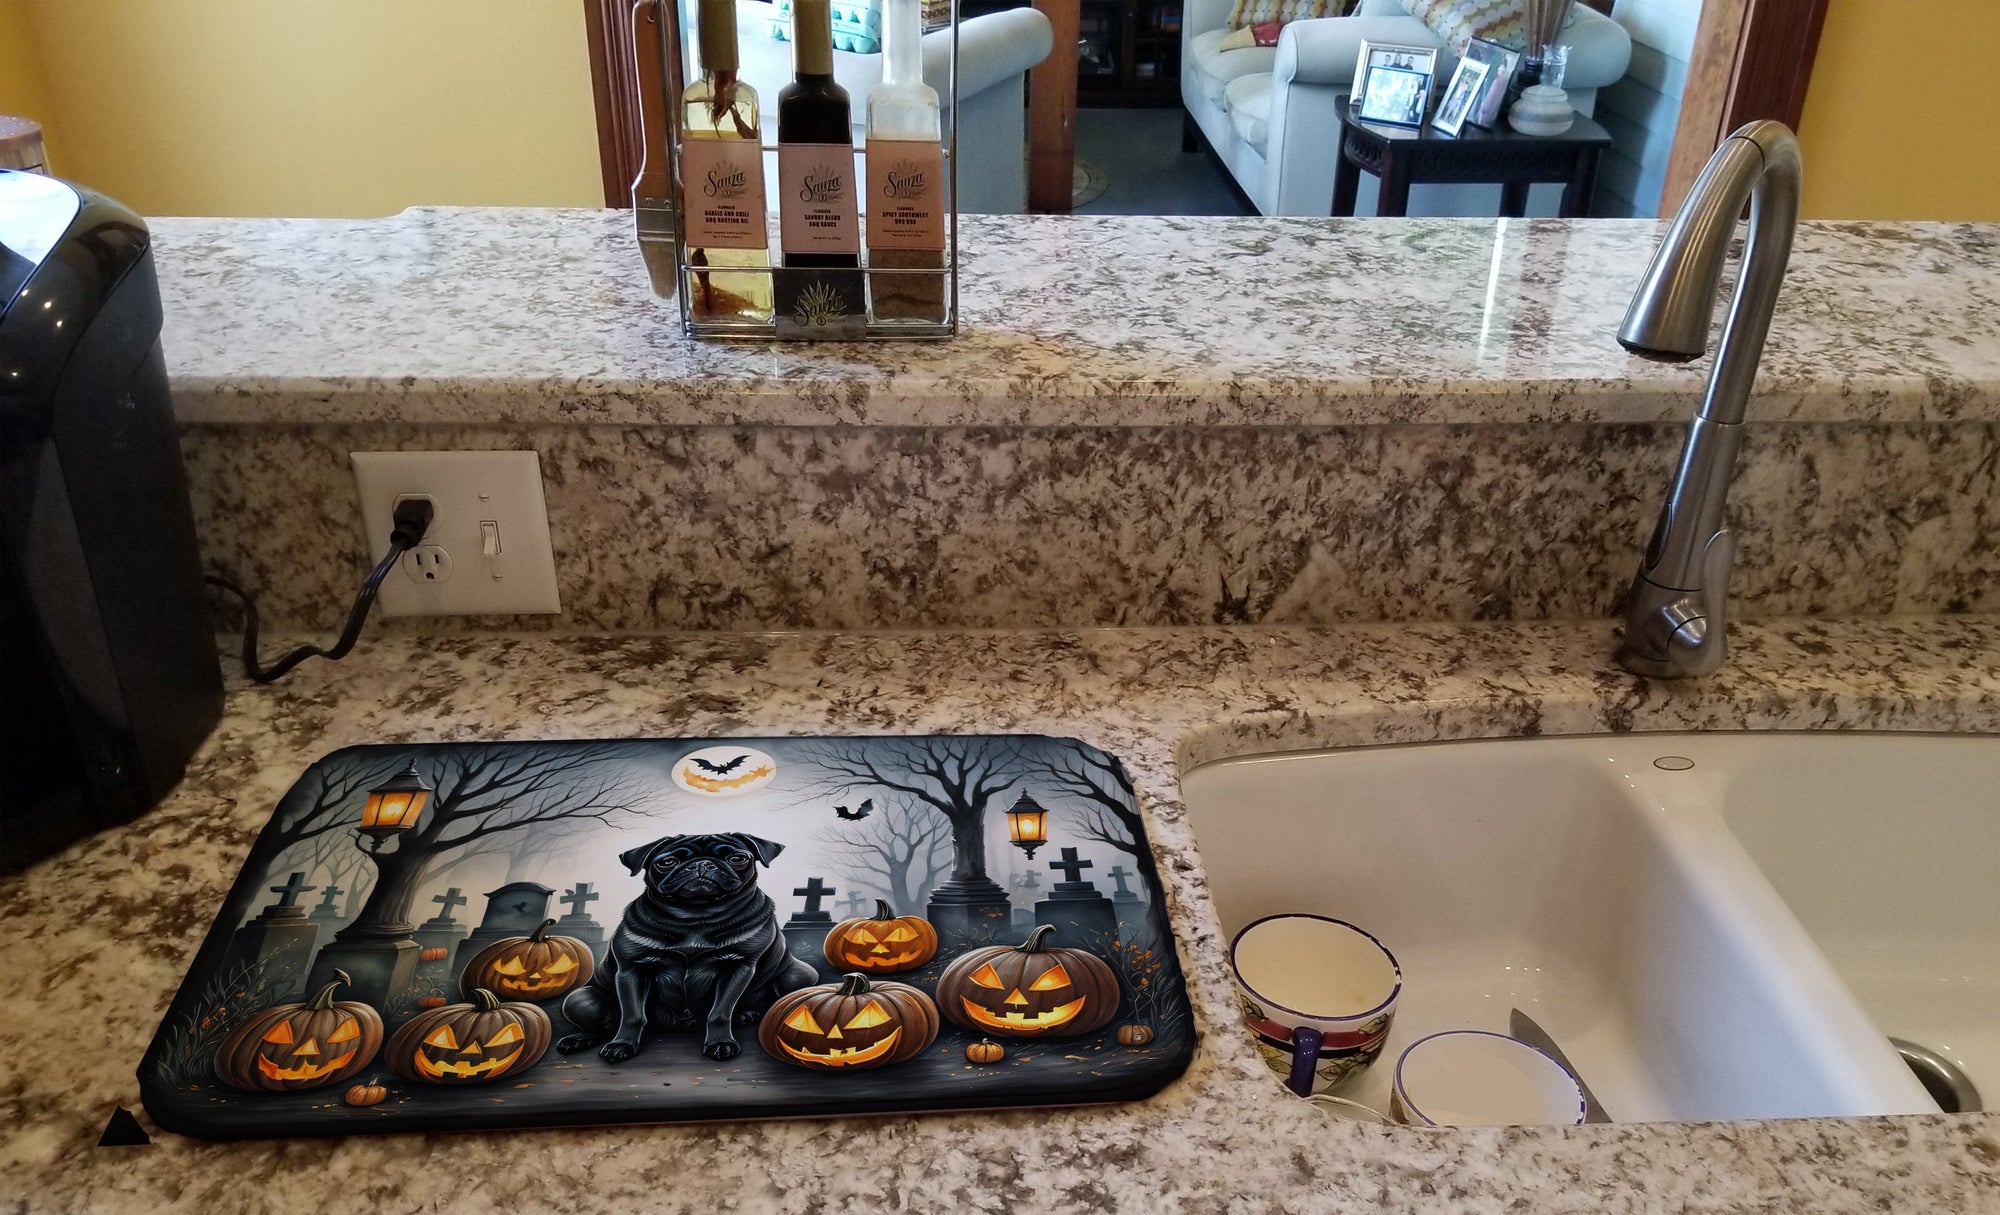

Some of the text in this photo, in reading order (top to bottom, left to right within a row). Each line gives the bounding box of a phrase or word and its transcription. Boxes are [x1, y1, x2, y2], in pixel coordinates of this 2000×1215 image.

[704, 170, 745, 197] Sauza
[800, 175, 841, 201] Sauza
[883, 171, 925, 198] Sauza
